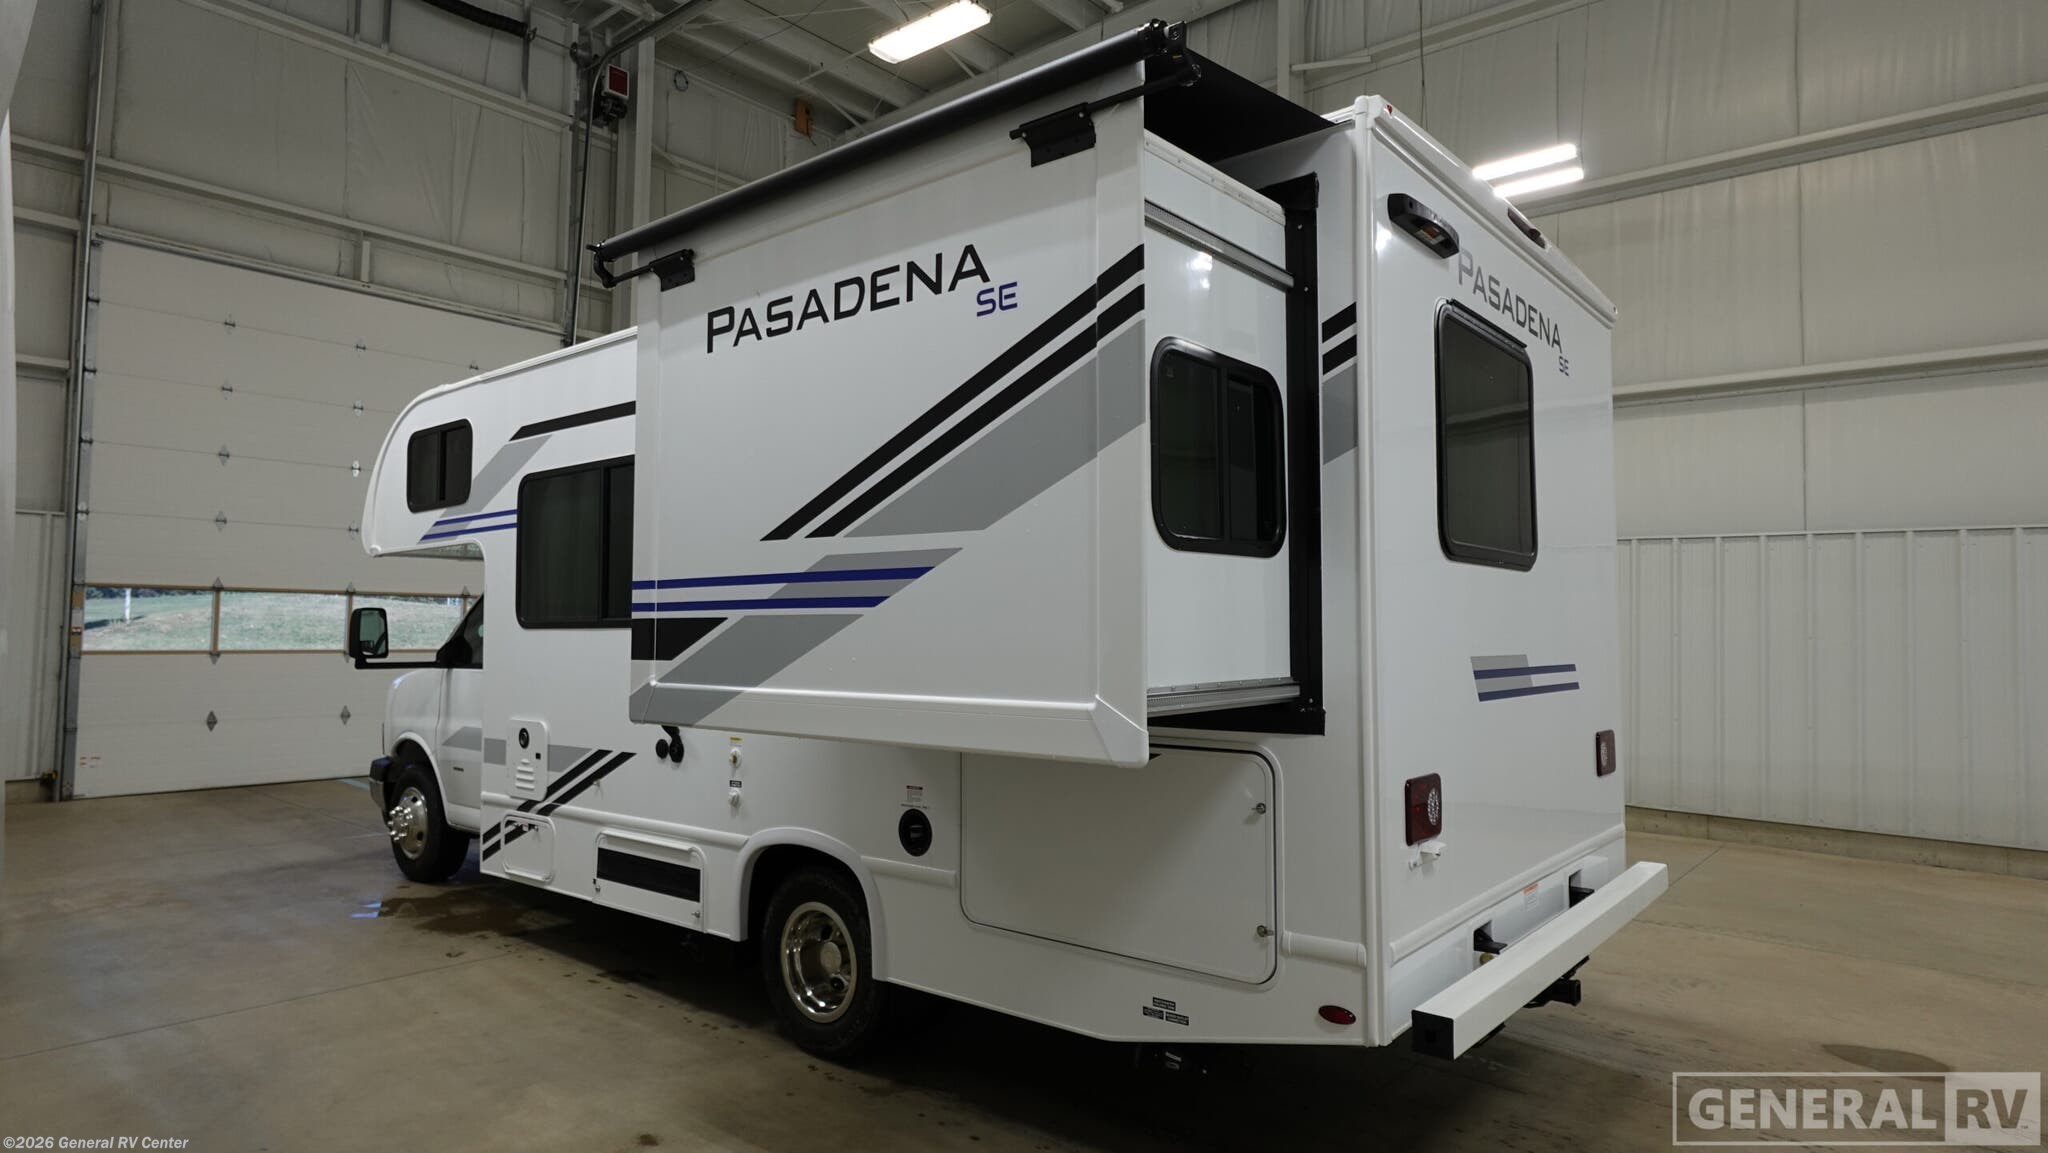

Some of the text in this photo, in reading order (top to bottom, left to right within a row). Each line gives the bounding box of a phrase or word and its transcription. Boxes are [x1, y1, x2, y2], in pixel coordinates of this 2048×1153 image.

[707, 244, 991, 354] PASADENA
[976, 282, 1018, 317] SE
[1458, 247, 1562, 354] PASADENA
[1559, 355, 1569, 376] SE
